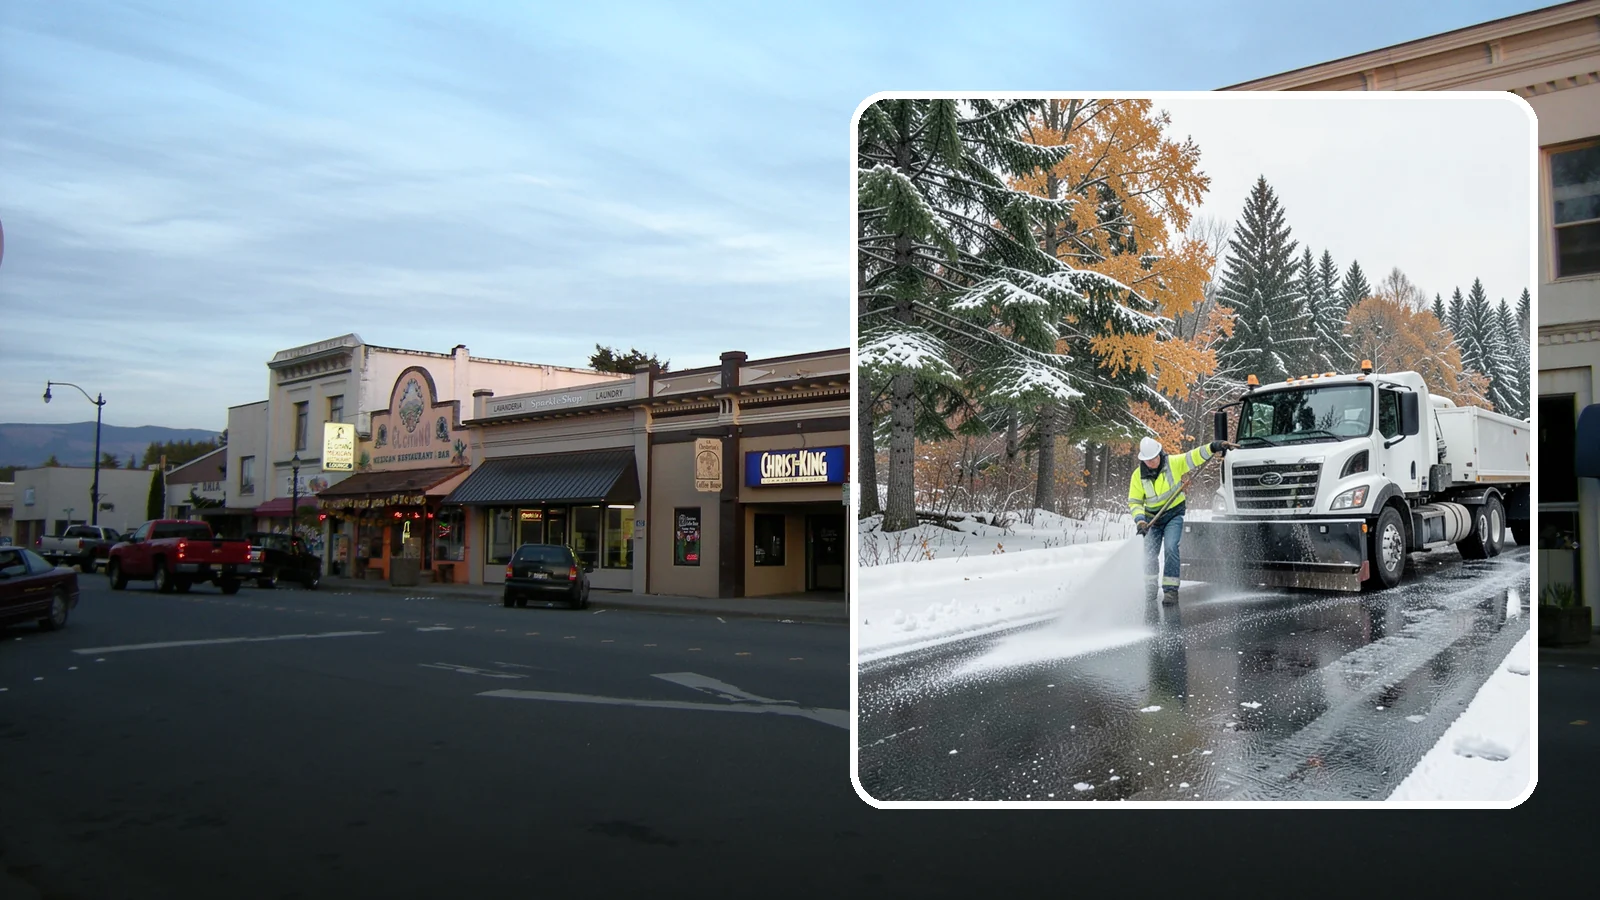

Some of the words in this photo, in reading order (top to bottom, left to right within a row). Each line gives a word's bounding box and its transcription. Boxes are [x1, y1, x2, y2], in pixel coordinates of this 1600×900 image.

[530, 396, 562, 409] Sparkle
[562, 394, 583, 405] Shop
[595, 389, 624, 400] LAUNDRY
[493, 402, 522, 412] LAVANDERIA
[392, 425, 402, 449] EL
[373, 454, 396, 464] MEXICAN
[397, 451, 434, 463] RESTAURANT
[437, 450, 450, 459] BAR
[761, 452, 797, 478] CHRIST
[799, 450, 827, 476] KING
